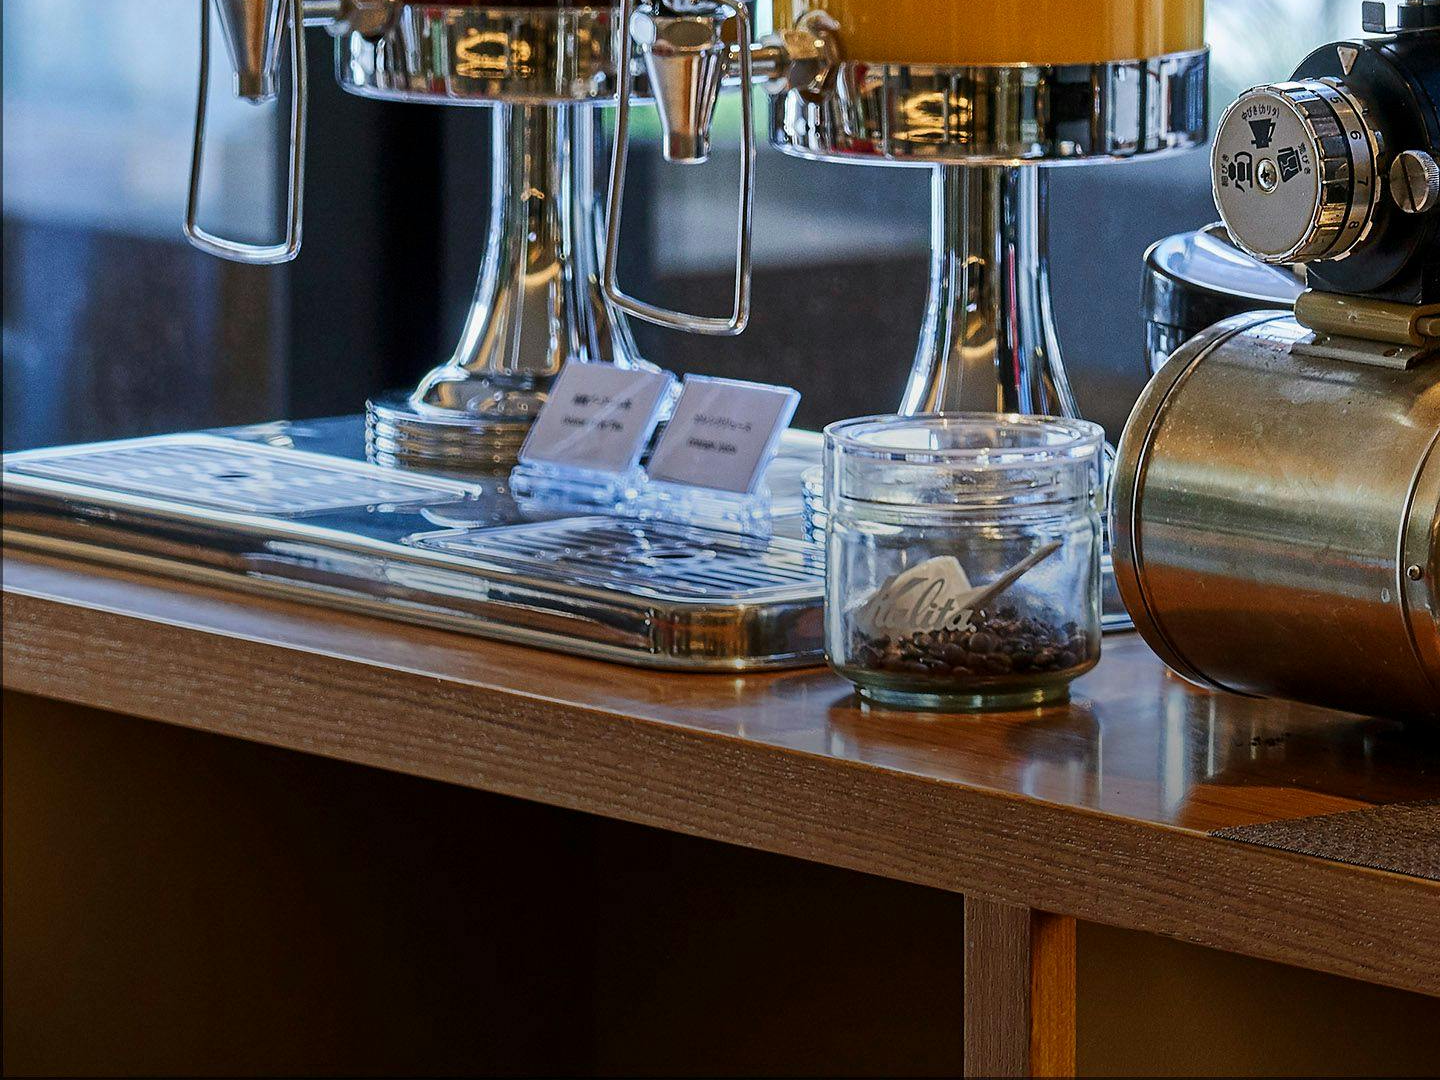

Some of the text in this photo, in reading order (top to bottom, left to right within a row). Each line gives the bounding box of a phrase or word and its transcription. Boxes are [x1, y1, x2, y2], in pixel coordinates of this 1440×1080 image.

[1330, 96, 1343, 105] 5
[1350, 130, 1361, 140] 6
[1357, 177, 1368, 187] 7
[1348, 221, 1360, 230] 8
